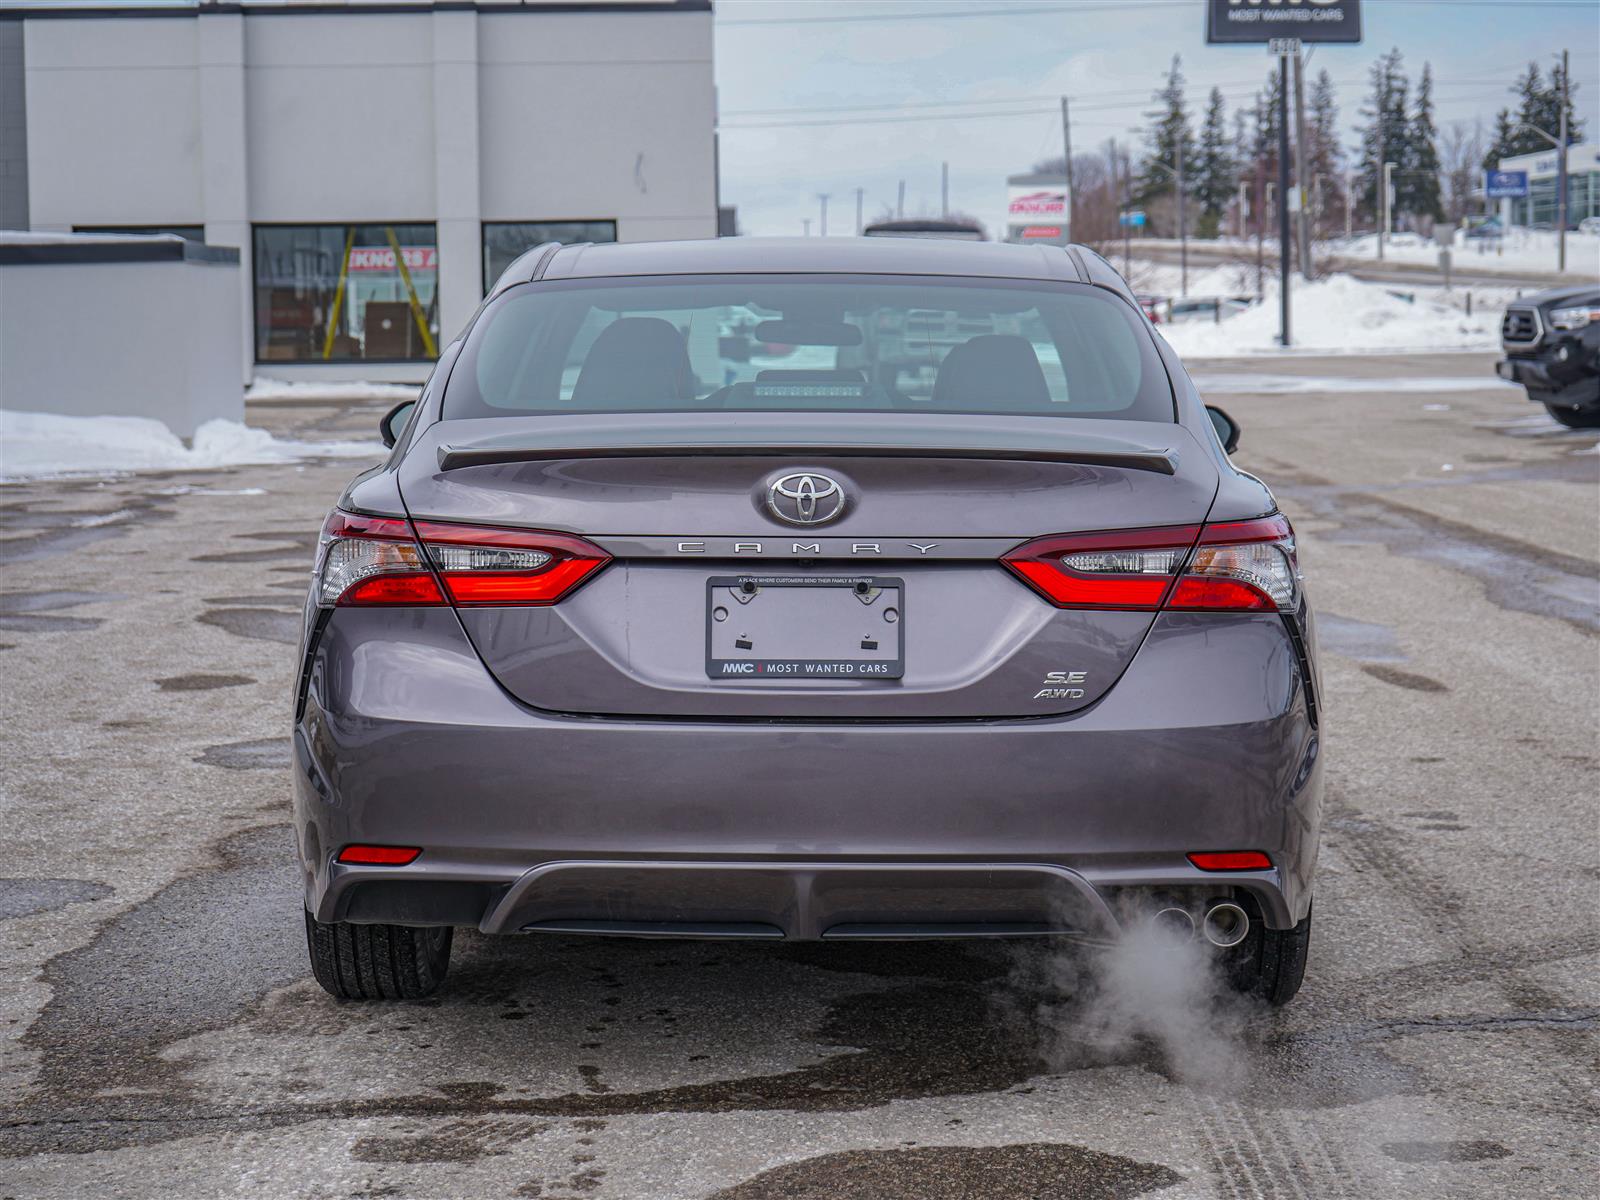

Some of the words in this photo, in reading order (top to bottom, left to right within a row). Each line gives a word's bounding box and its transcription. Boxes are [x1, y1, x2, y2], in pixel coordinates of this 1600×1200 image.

[1228, 9, 1261, 21] MOST
[1262, 9, 1312, 21] WANTED
[1312, 8, 1344, 21] CARS
[677, 542, 940, 554] CAMRY
[767, 664, 799, 673] MOST
[805, 664, 854, 673] WANTED
[859, 664, 888, 673] CARS
[1043, 671, 1088, 684] SE
[1033, 688, 1085, 699] AWD
